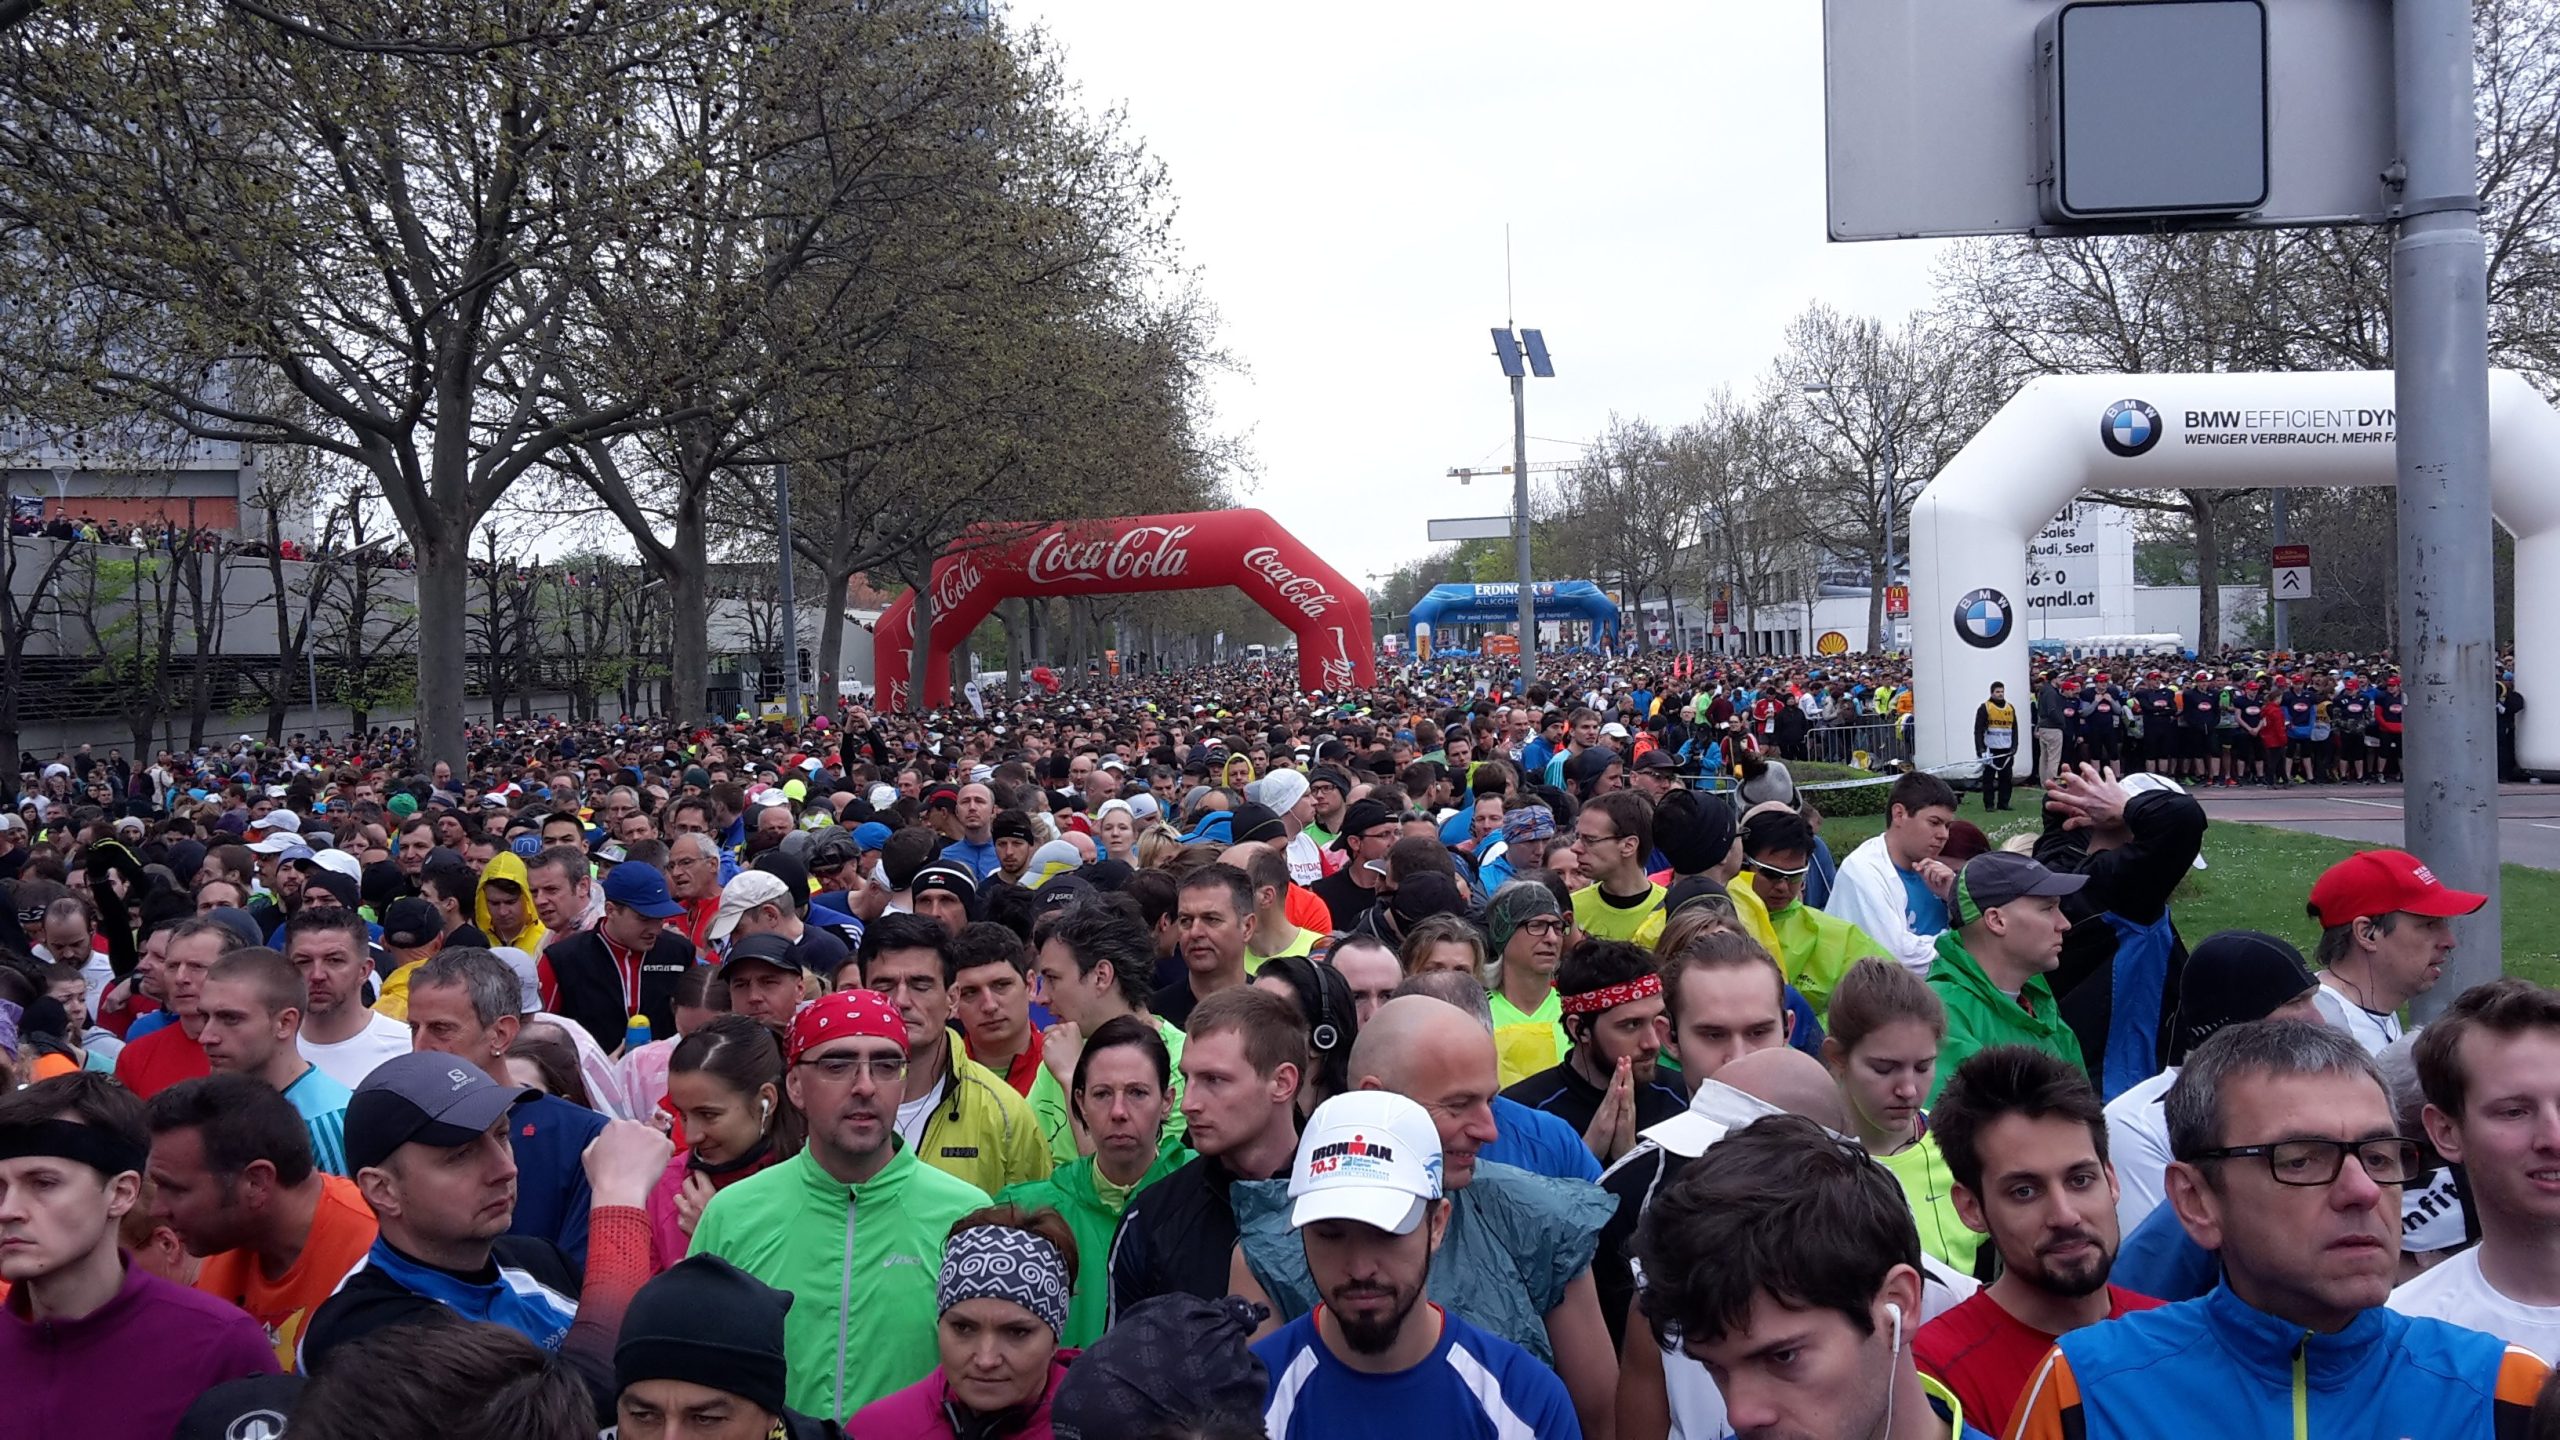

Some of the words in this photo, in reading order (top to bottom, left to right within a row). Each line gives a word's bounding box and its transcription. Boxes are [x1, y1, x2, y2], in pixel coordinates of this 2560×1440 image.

[2106, 400, 2157, 419] BMW
[2184, 411, 2241, 428] BMW
[2184, 433, 2248, 444] WENIGER
[2250, 431, 2339, 444] VERBRAUCH.
[2342, 431, 2382, 442] MEHR
[2040, 525, 2076, 539] Sales
[1027, 524, 1196, 584] Coca-Cola
[2029, 543, 2062, 556] Audi,
[2065, 542, 2095, 554] Seat
[1243, 547, 1340, 620] Coca-Cola
[1960, 590, 2009, 610] BMW
[1311, 1135, 1394, 1164] IRONMAN
[1309, 1157, 1338, 1178] 70.3
